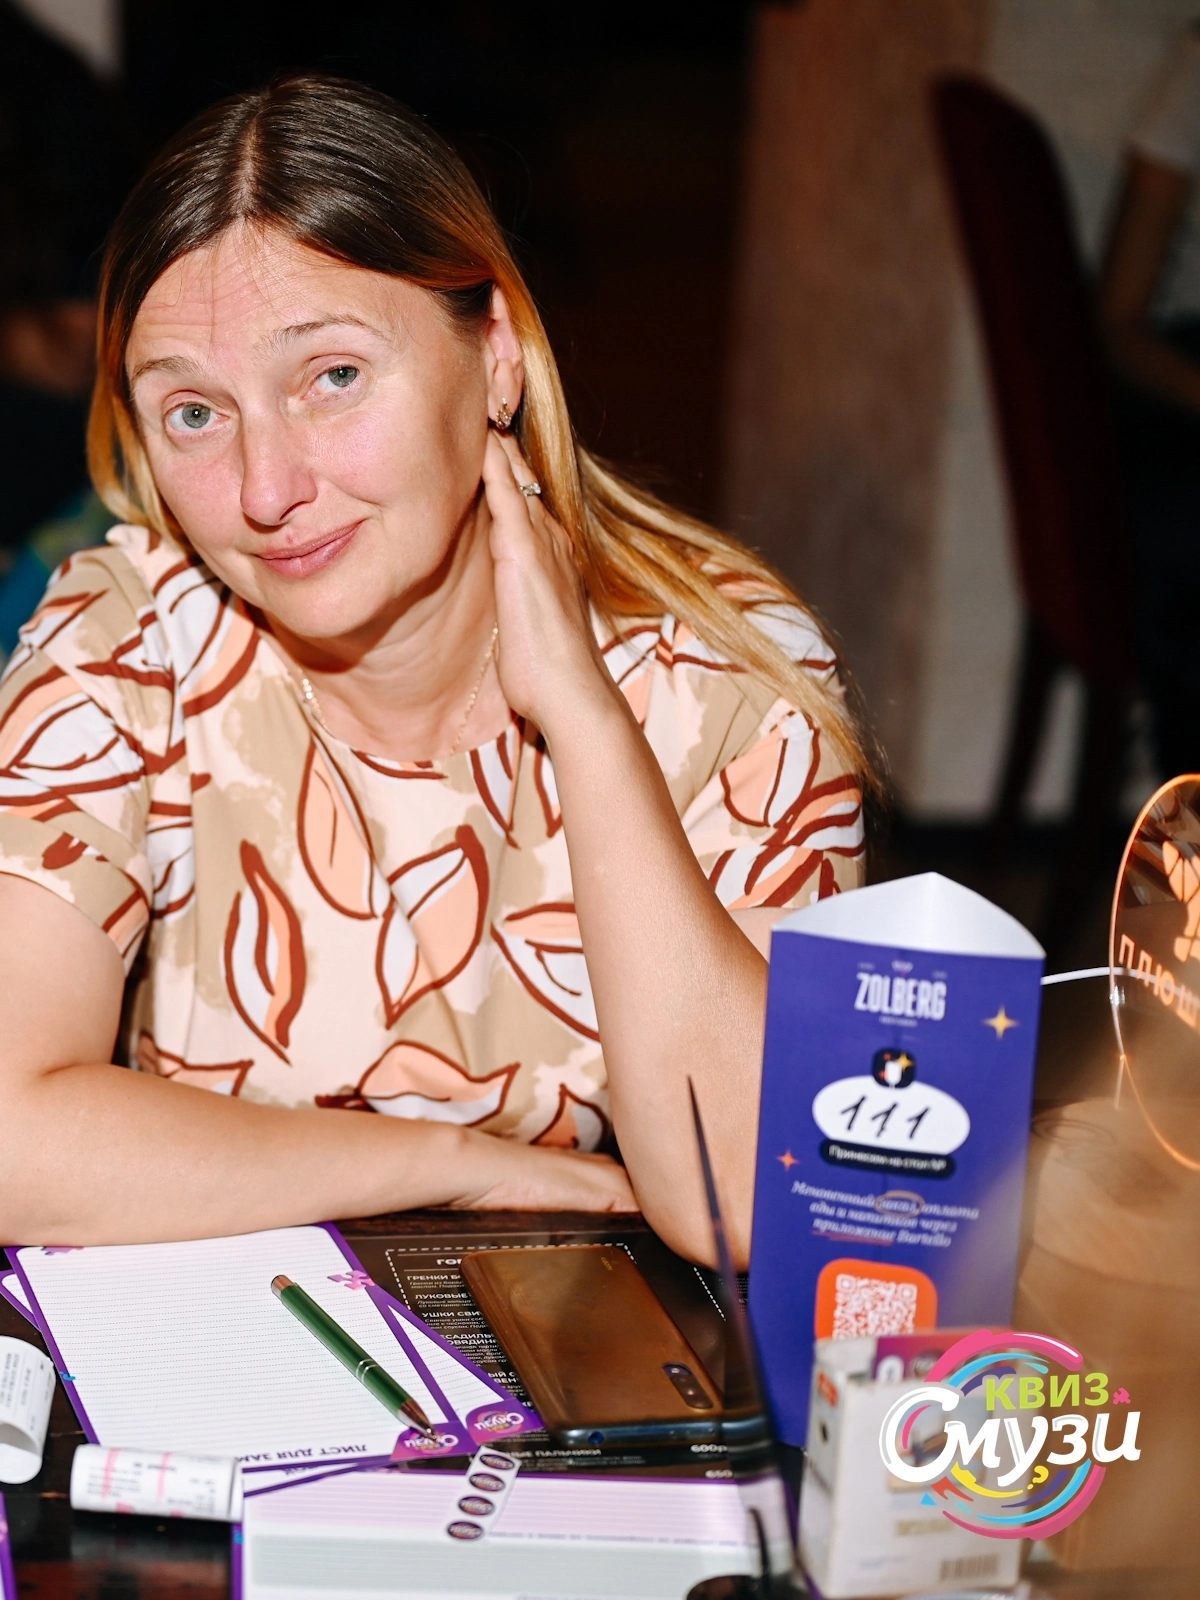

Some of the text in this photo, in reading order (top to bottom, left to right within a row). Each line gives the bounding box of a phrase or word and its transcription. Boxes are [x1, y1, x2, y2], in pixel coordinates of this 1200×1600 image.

[853, 971, 948, 1021] ZOLBERG
[415, 1292, 468, 1300] ЛУКОВЫЕ
[234, 1444, 368, 1463] ЛИСТ ДЛЯ ЗАМ
